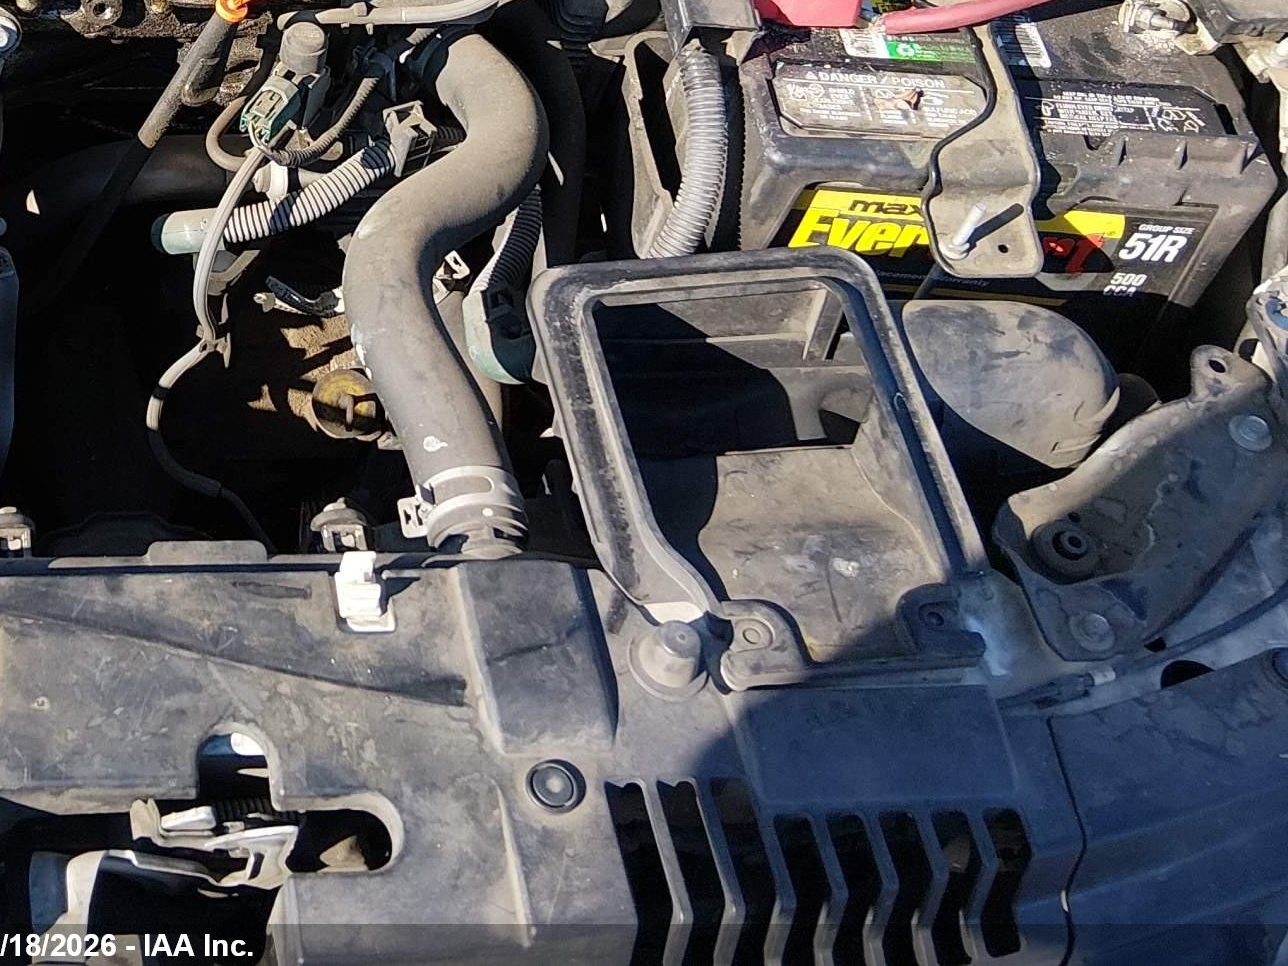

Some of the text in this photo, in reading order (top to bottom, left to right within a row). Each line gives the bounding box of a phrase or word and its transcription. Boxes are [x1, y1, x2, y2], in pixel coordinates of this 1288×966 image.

[818, 71, 877, 85] DANGER
[892, 76, 946, 89] POISON
[1138, 223, 1196, 235] GROUP SIZE
[1118, 232, 1188, 263] 51R
[1110, 272, 1148, 286] 500
